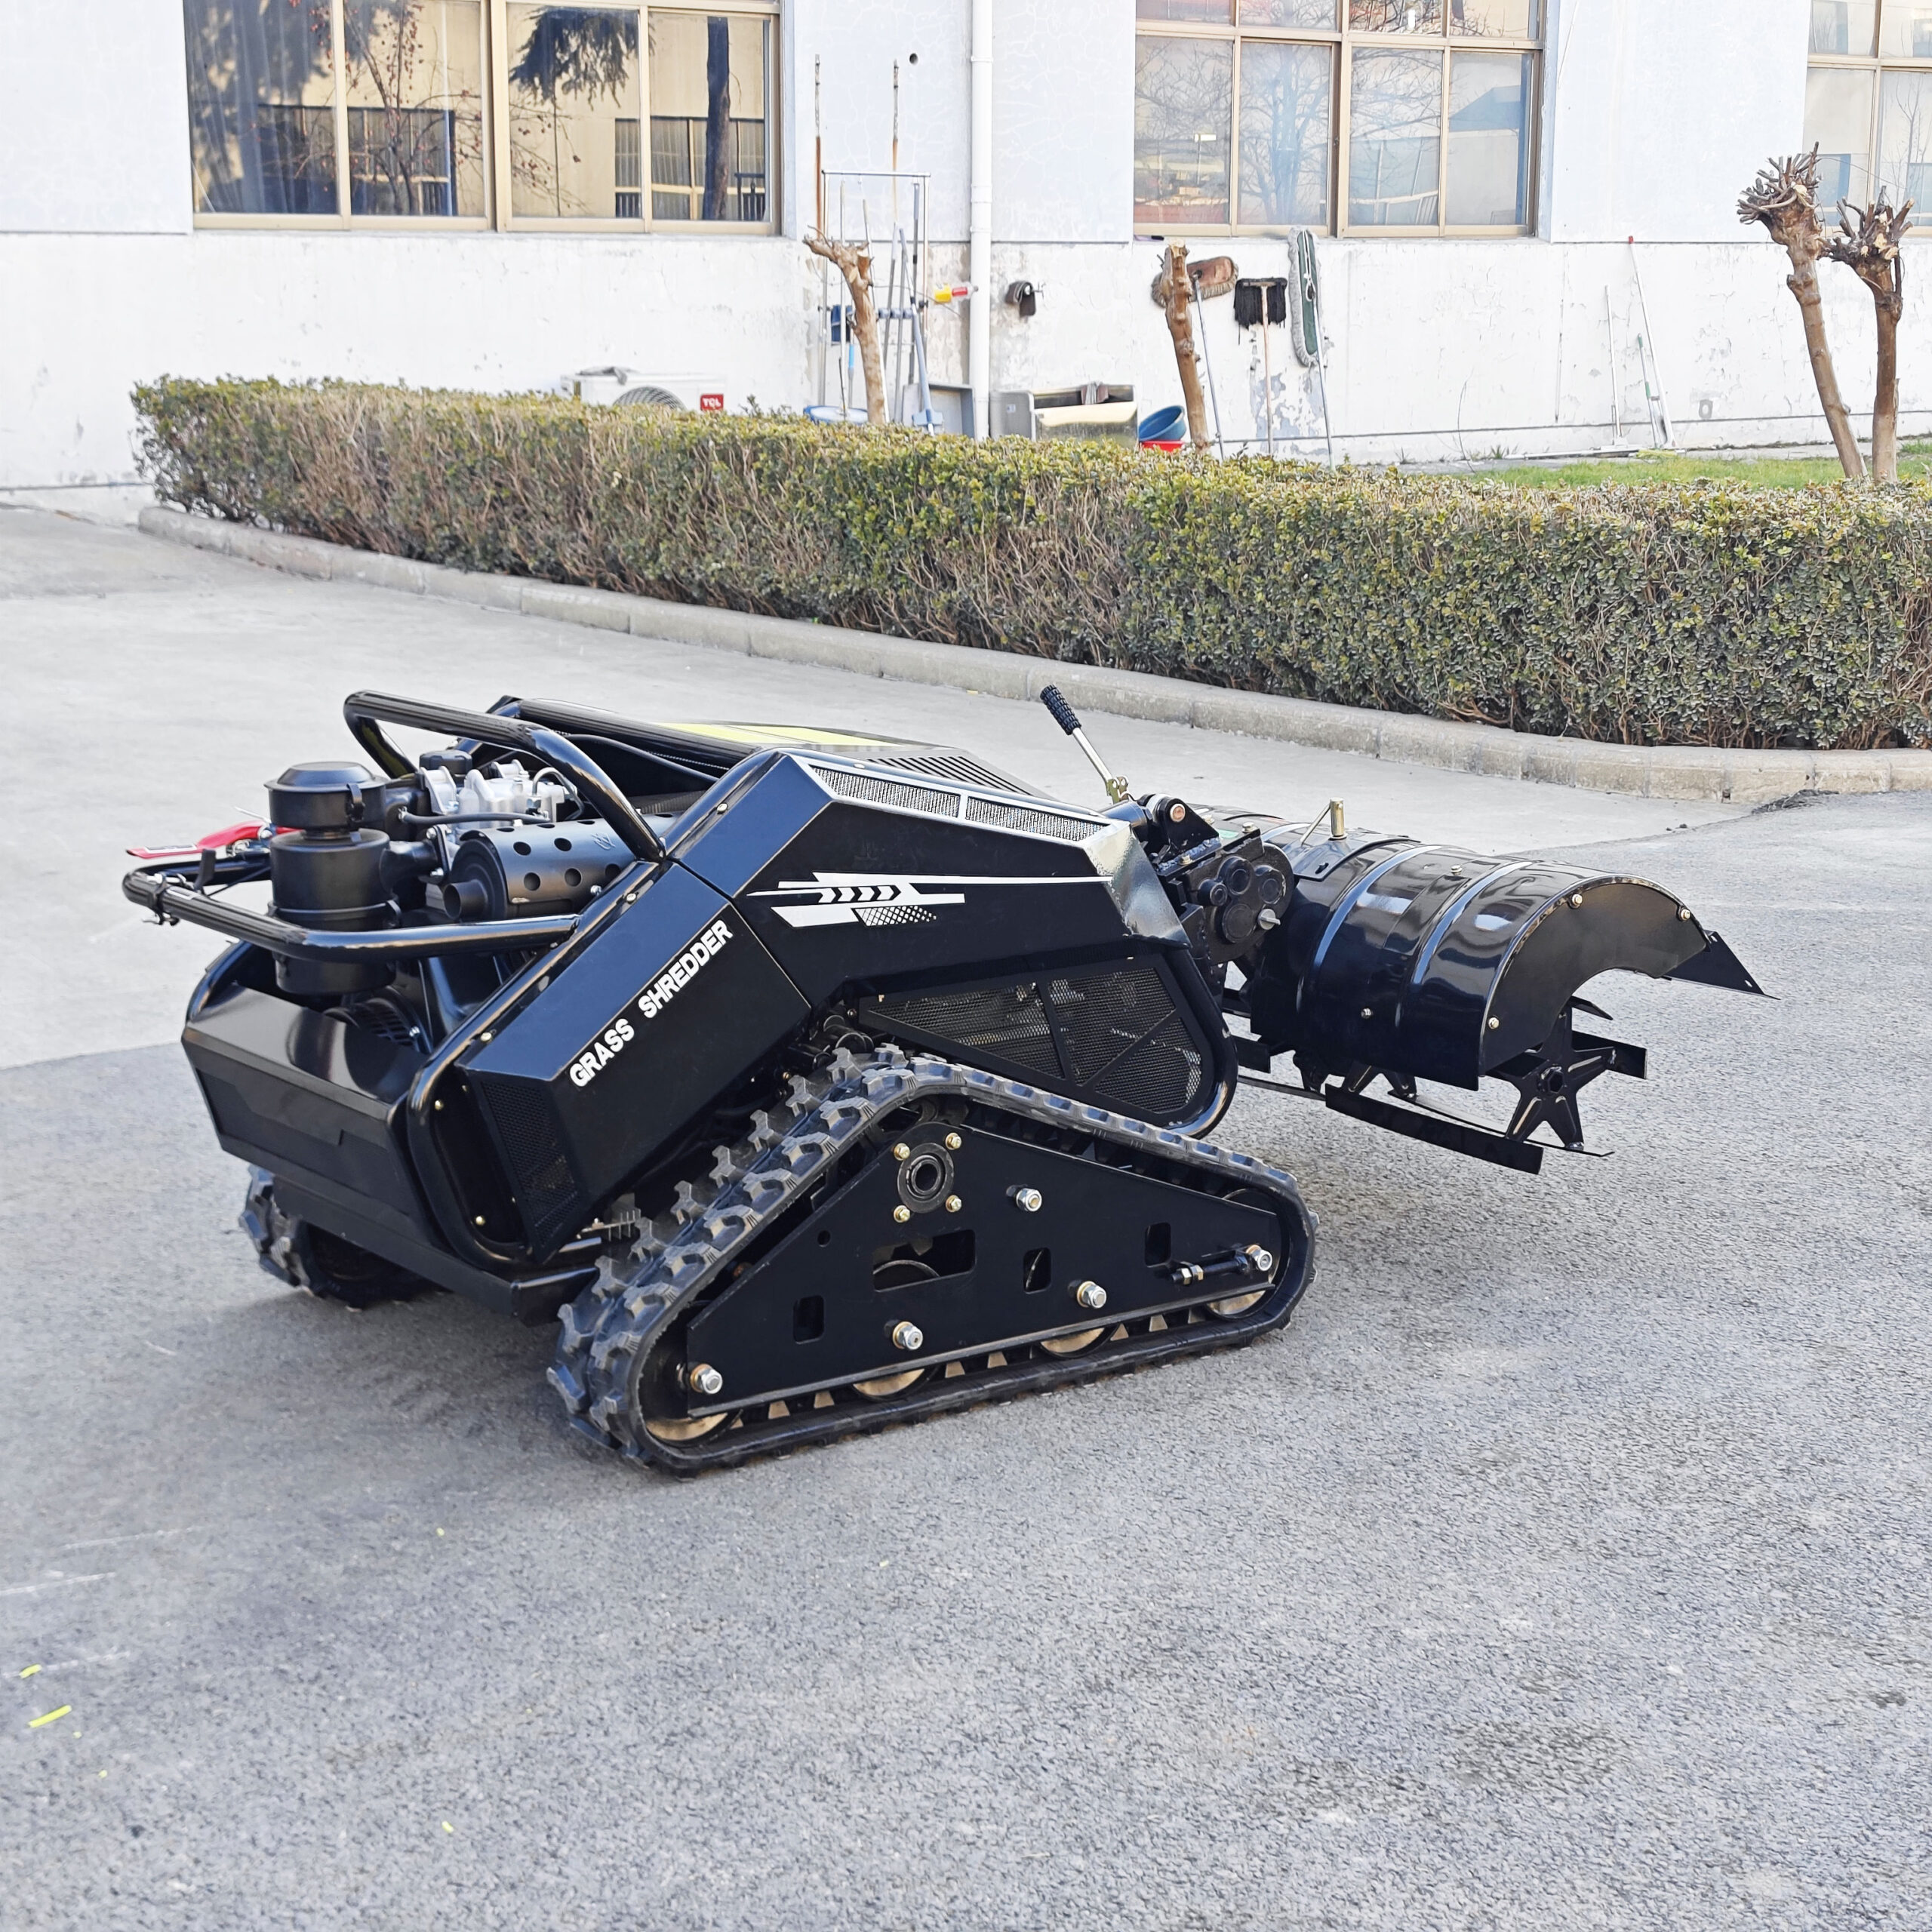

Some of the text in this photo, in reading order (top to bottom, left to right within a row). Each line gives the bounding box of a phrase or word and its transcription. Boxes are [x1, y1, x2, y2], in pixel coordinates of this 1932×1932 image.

[702, 397, 722, 408] TCL
[569, 919, 734, 1087] GRASS SHREDDER
